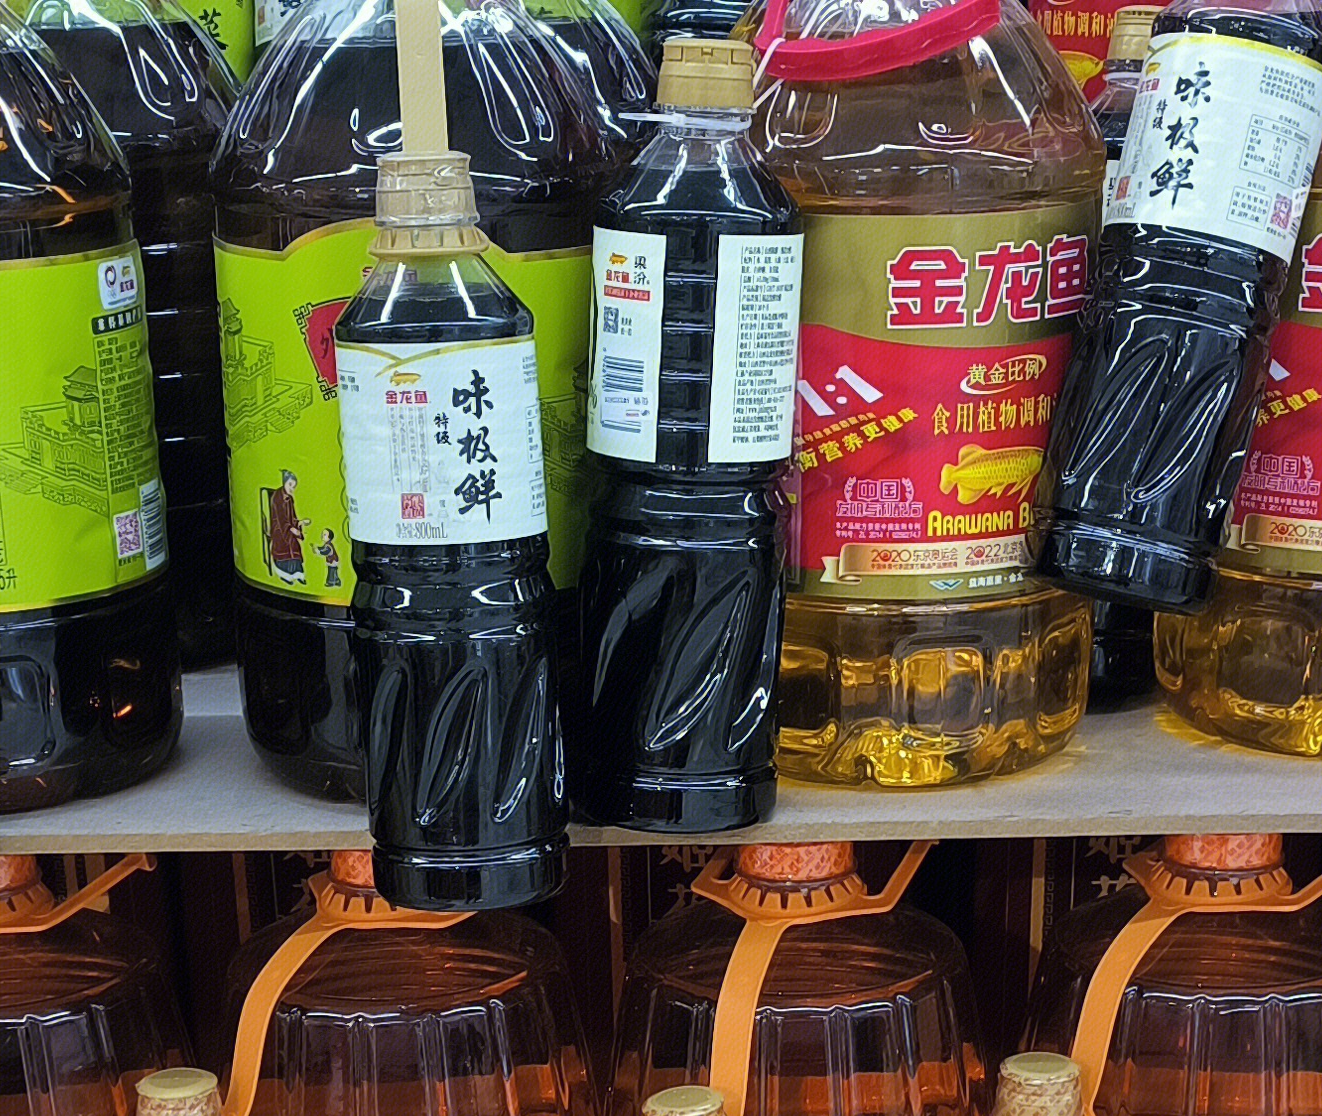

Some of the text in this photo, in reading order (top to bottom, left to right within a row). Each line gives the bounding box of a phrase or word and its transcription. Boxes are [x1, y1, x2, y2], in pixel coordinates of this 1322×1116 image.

[1150, 61, 1212, 210] 味极鲜
[886, 233, 1089, 329] 金龙鱼
[967, 355, 1041, 386] 黄金比例
[386, 390, 429, 405] 金龙鱼
[931, 392, 1057, 437] 食用植物调和
[434, 412, 452, 446] 特级
[452, 369, 502, 525] 味极鲜
[927, 510, 1014, 538] ARAWANA
